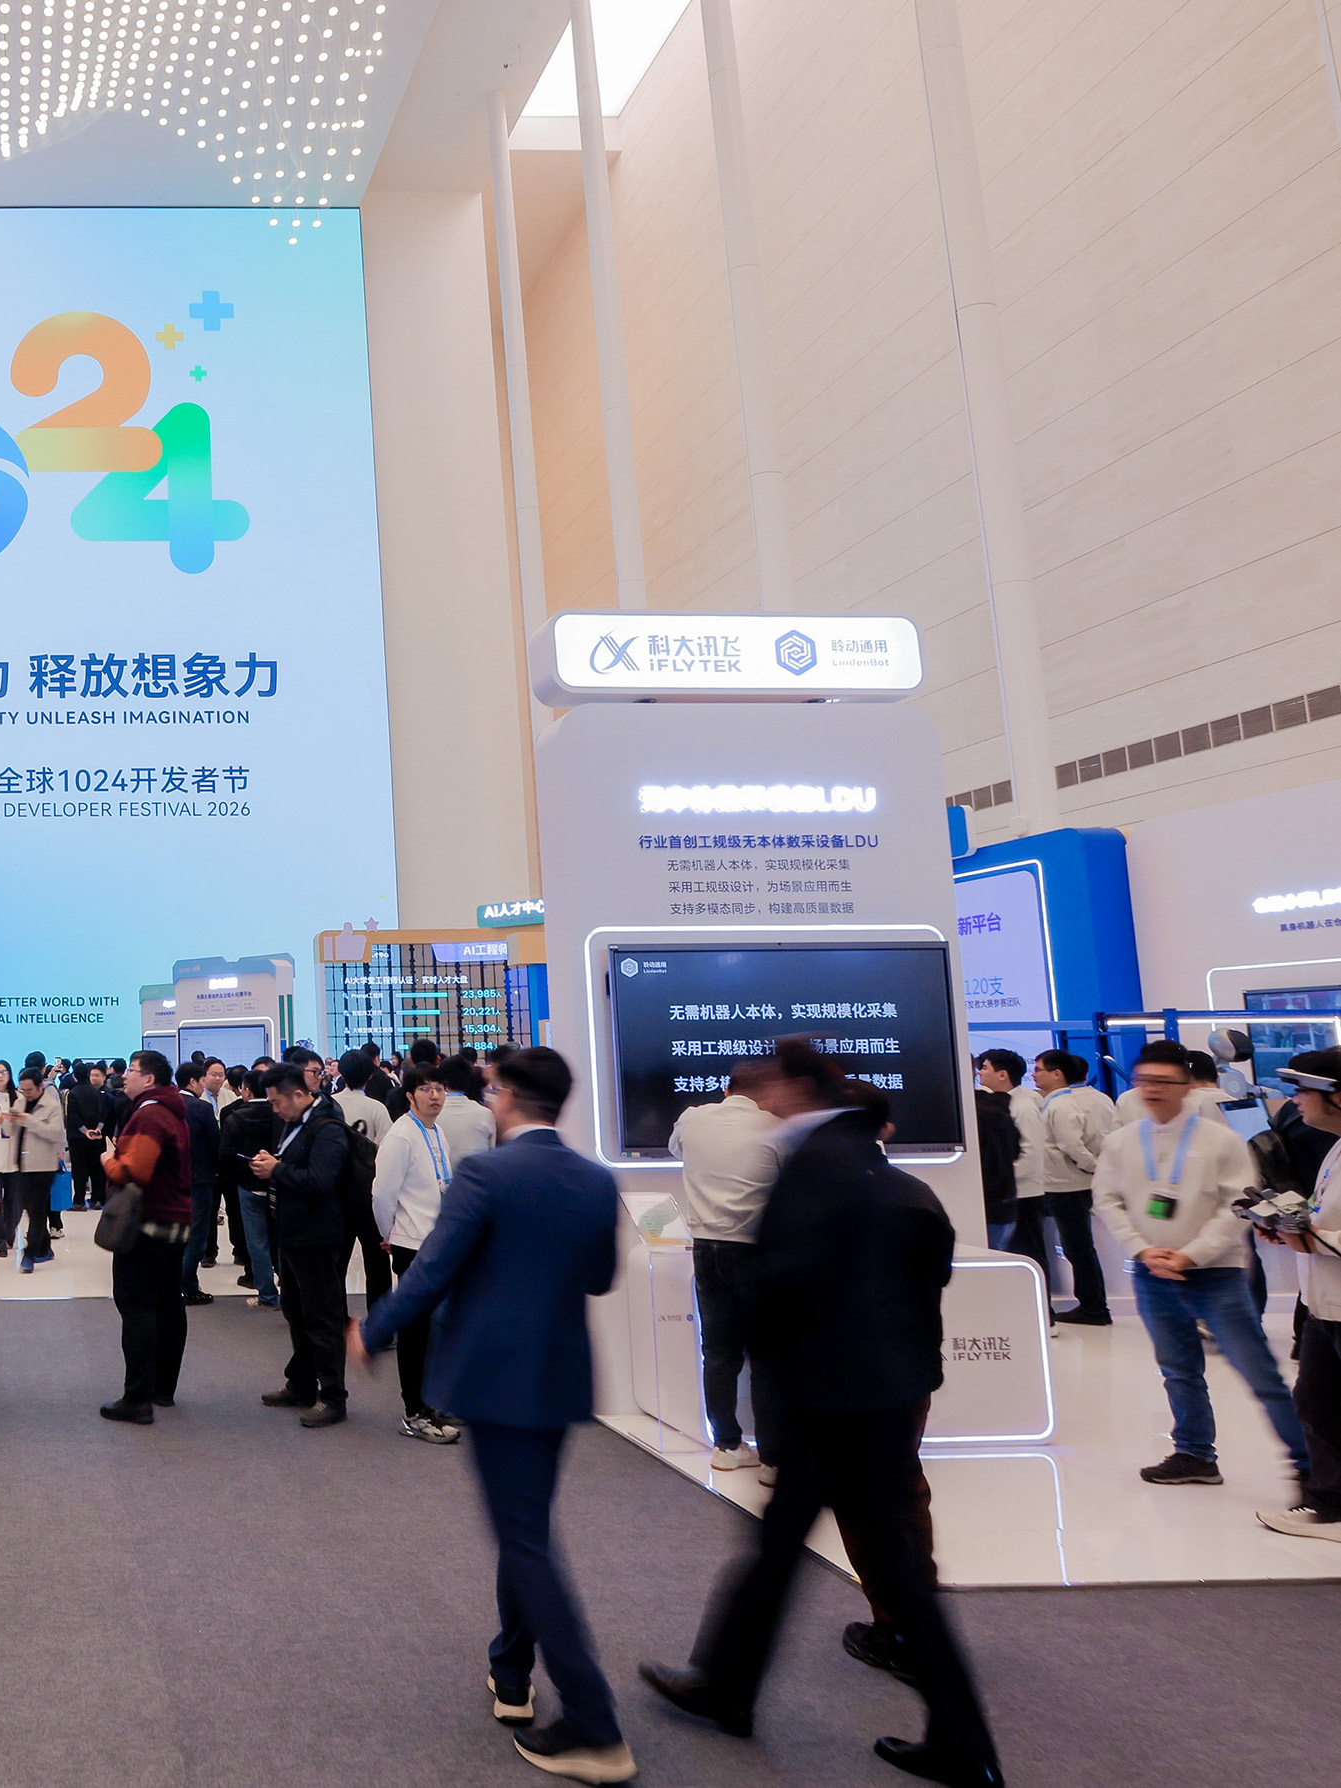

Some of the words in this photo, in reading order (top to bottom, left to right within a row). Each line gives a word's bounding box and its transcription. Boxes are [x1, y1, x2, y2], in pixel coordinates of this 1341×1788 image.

[647, 634, 742, 657] 科大讯飞
[830, 638, 888, 654] 聆动通用
[649, 659, 743, 673] iFLYTEK
[831, 657, 890, 668] LindenBot
[28, 650, 279, 700] 释放想象力
[26, 710, 115, 725] UNLEASH
[123, 710, 250, 725] IMAGINATION
[3, 802, 113, 818] DEVELOPER
[119, 801, 203, 817] FESTIVAL
[207, 801, 251, 817] 2026
[638, 834, 879, 850] 行业首创工规级无本体数采设备LDU
[666, 859, 851, 872] 无需机器人本体，实现规模化采集
[668, 880, 852, 894] 采用工规级设计，为场景应用而生
[670, 902, 854, 916] 支持多模态同步，构建高质量数据
[957, 912, 1002, 936] 新平台
[462, 989, 502, 999] 23,985人
[40, 997, 85, 1007] WORLD
[88, 996, 119, 1007] WITH
[16, 1013, 104, 1024] INTELLIGENCE
[463, 1007, 502, 1016] 20,221人
[669, 1002, 898, 1022] 无需机器人本体，实现规模化采集
[463, 1024, 503, 1034] 15,304人
[951, 1336, 1012, 1351] 科大讯飞
[951, 1351, 1012, 1361] iFLYTEK
